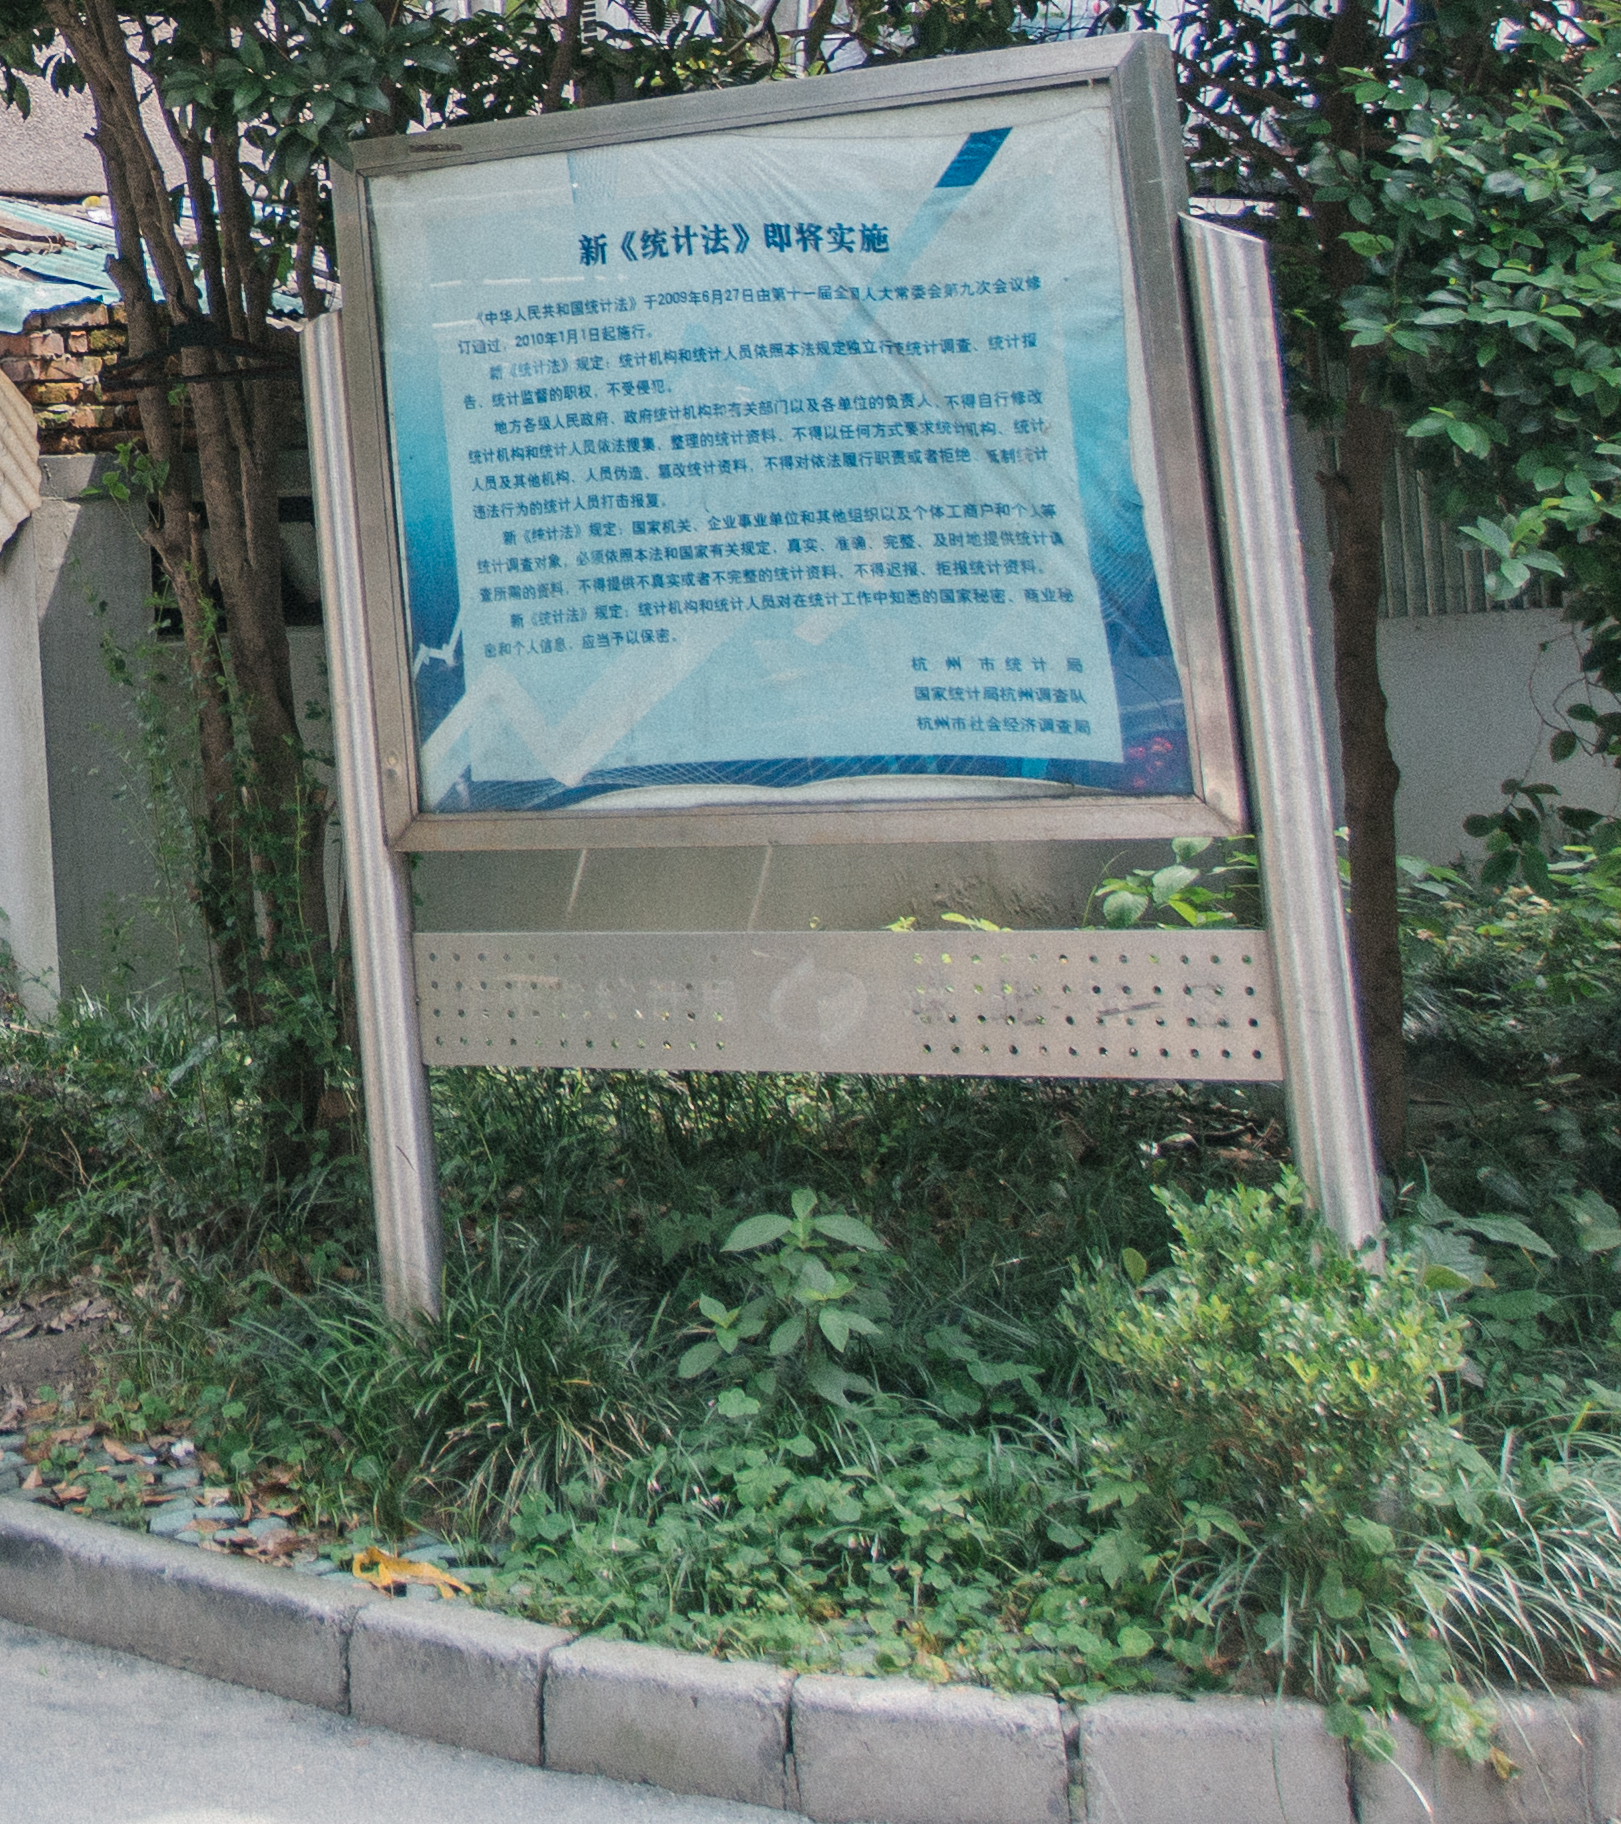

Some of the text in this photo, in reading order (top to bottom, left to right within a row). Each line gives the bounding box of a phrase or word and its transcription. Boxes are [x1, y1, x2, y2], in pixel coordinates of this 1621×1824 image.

[578, 222, 890, 266] 新《统计法》即将实施
[473, 492, 666, 520] 违法行为的统计人员打击报复。
[914, 686, 1087, 704] 国家统计局杭州调查队
[917, 716, 1091, 735] 杭州市社会经济调查局
